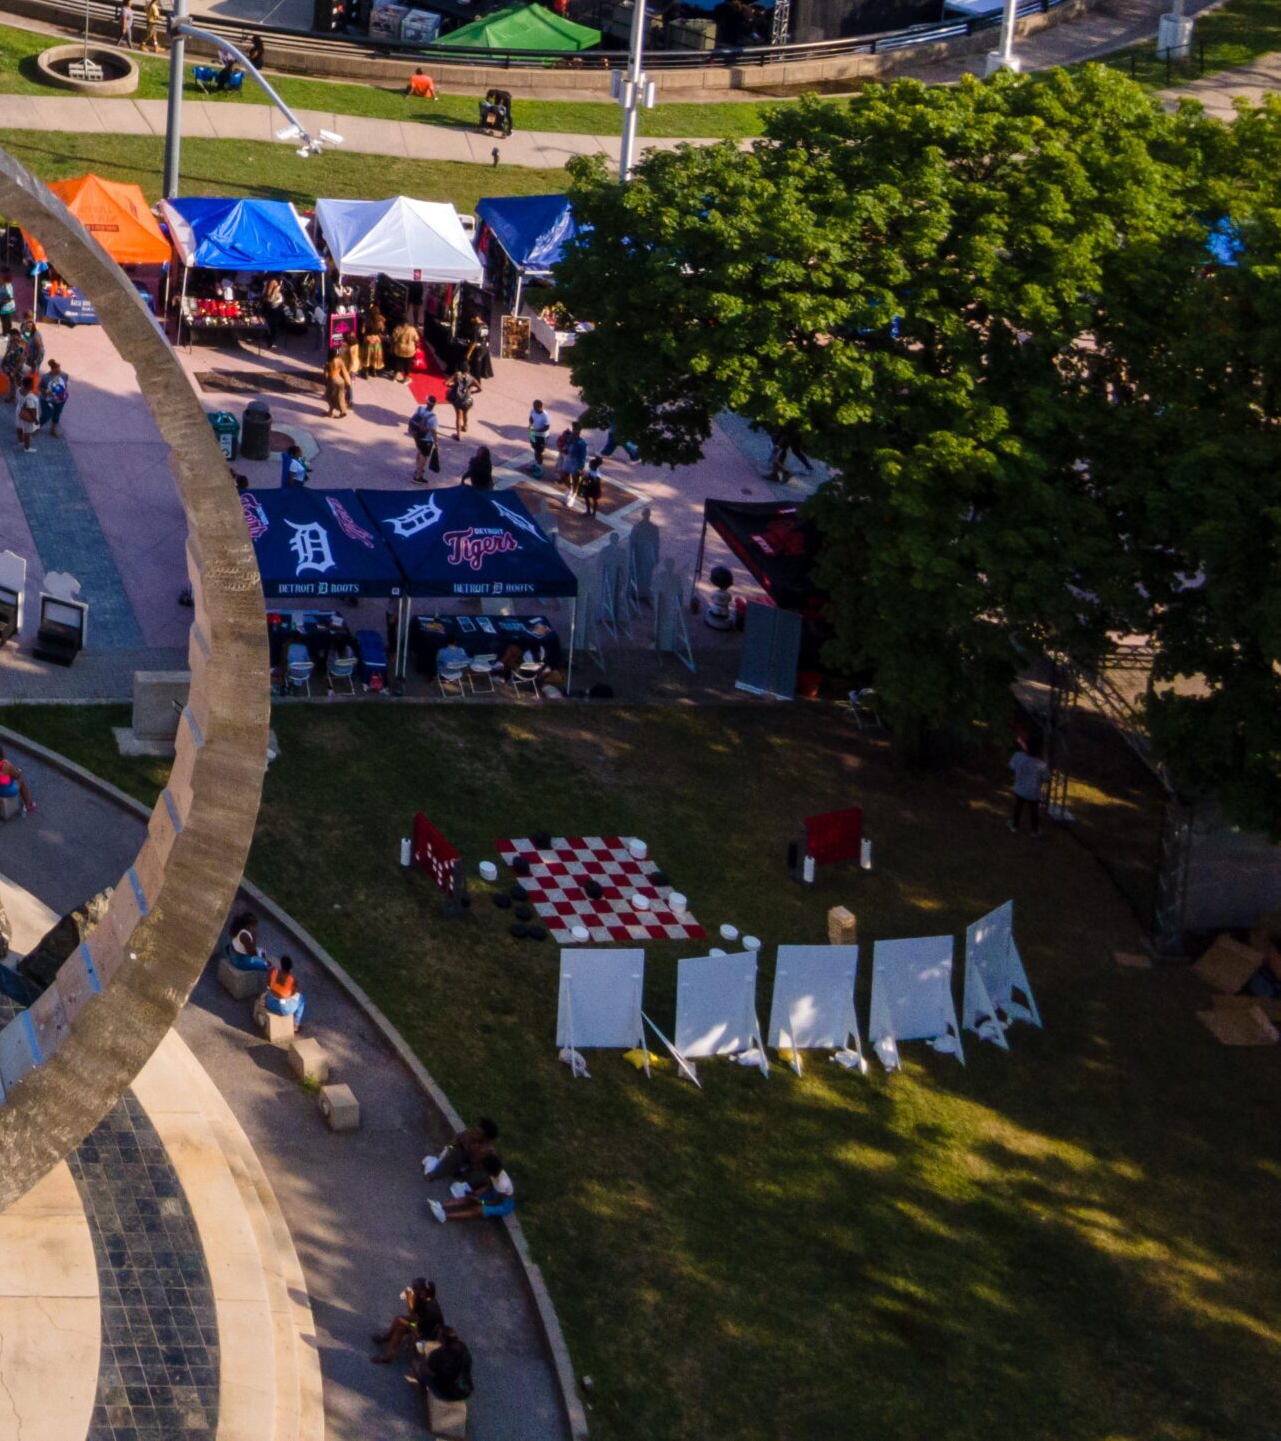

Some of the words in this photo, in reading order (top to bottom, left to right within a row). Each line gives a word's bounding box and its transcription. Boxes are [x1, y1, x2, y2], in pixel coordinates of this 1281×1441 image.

[474, 527, 504, 535] DETROIT
[442, 526, 518, 571] Tigers
[279, 584, 315, 594] DETROIT
[331, 584, 359, 594] ROOTS
[453, 583, 490, 594] DETROIT
[505, 584, 535, 593] ROOTS
